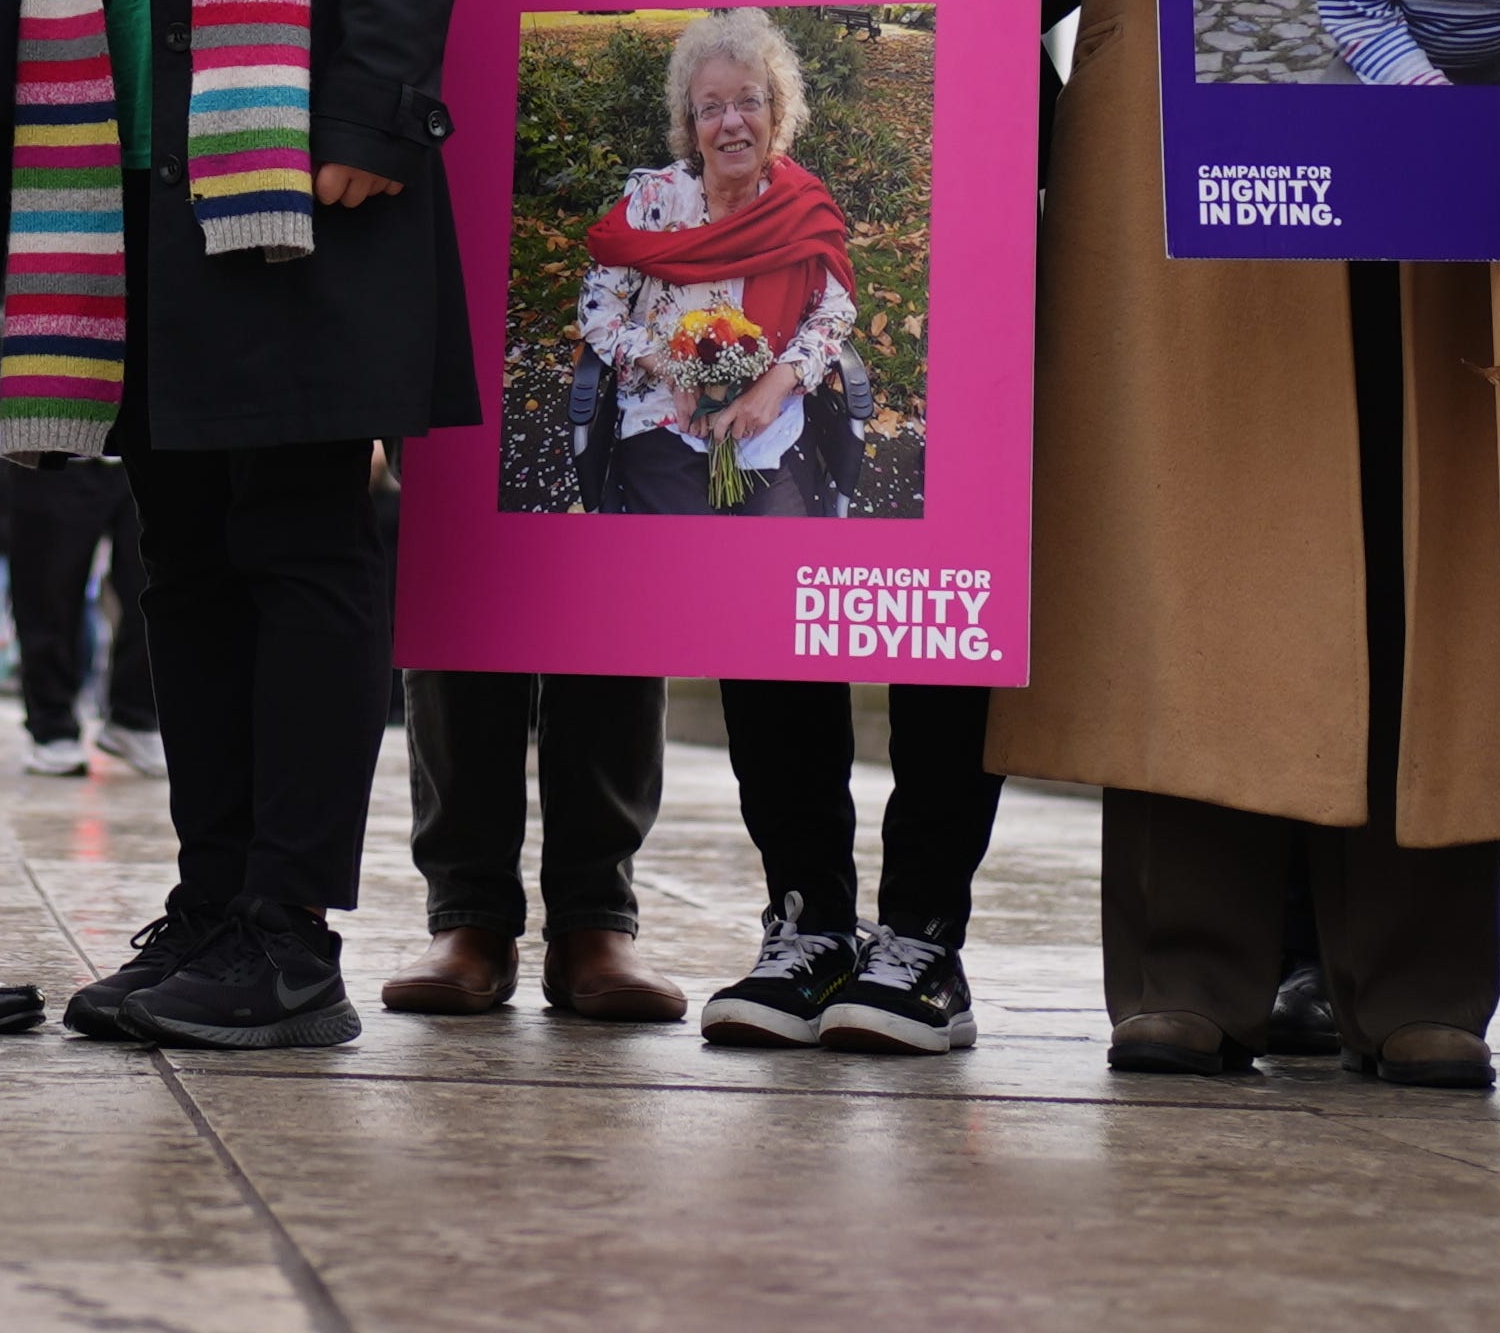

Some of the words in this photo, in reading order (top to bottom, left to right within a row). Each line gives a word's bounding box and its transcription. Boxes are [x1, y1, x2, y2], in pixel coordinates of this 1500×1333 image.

[1199, 166, 1290, 178] CAMPAIGN
[1297, 167, 1330, 179] FOR
[1199, 180, 1330, 202] DIGNITY
[1200, 203, 1230, 224] IN
[798, 567, 929, 587] CAMPAIGN
[941, 570, 990, 588] FOR
[796, 588, 989, 624] DIGNITY
[796, 623, 838, 655] IN
[850, 625, 1002, 660] DYING.
